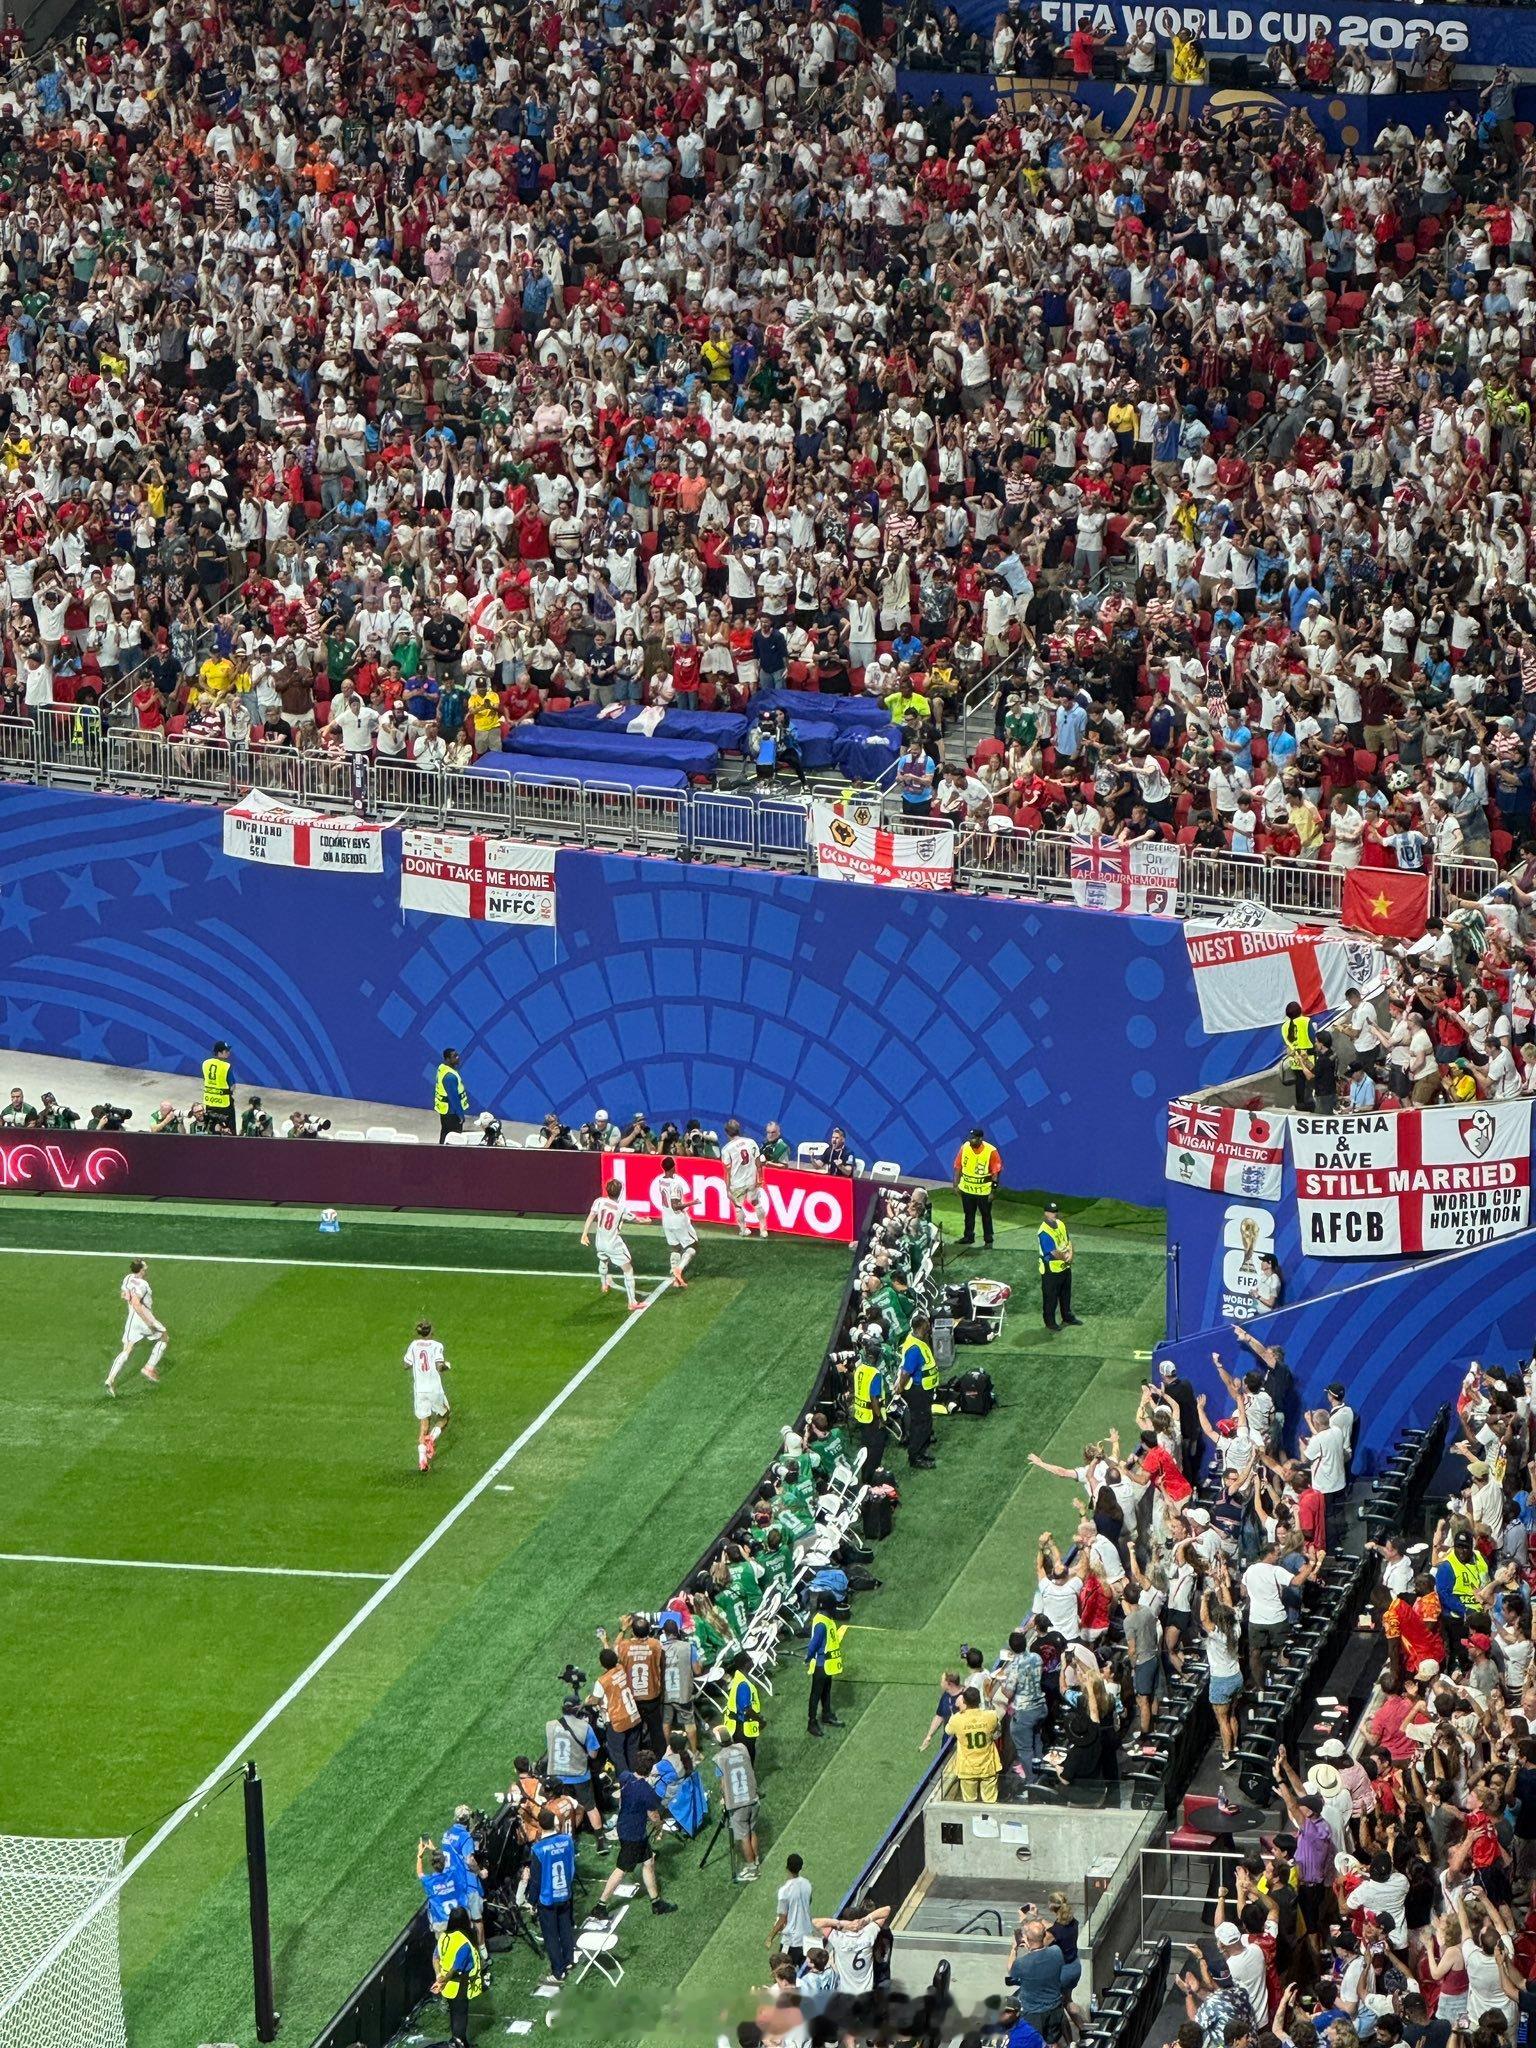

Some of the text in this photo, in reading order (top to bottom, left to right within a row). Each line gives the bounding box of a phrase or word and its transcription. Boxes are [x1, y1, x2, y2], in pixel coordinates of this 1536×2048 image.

[1041, 1, 1470, 52] FIFA WORLD CUP 2026
[236, 819, 258, 834] OVER
[259, 824, 282, 837] LAND
[250, 834, 267, 846] AND
[250, 845, 266, 858] SEA
[335, 852, 340, 863] A
[1147, 853, 1162, 864] On
[405, 857, 550, 888] DONT TAKE ME HOME
[898, 869, 953, 884] WOLVES
[1076, 869, 1178, 888] AFC BOURNEMOUTH
[1143, 863, 1170, 876] Tour
[489, 897, 536, 915] NFFC
[1187, 936, 1235, 964] WEST
[1297, 1116, 1389, 1135] SERENA
[1178, 1133, 1269, 1161] WIGAN ATHLETIC
[1336, 1136, 1350, 1152] &
[1315, 1152, 1372, 1169] DAVE
[1306, 1162, 1517, 1196] STILL MARRIED
[1433, 1189, 1522, 1211] WORLD CUP
[1430, 1206, 1521, 1229] HONEYMOON
[1311, 1211, 1384, 1244] AFCB
[1455, 1226, 1495, 1246] 2010
[1237, 1276, 1258, 1287] FIFA
[1223, 1294, 1254, 1306] WORLD
[1222, 1303, 1257, 1319] 202
[965, 1731, 987, 1749] 10
[852, 1946, 872, 1971] 6
